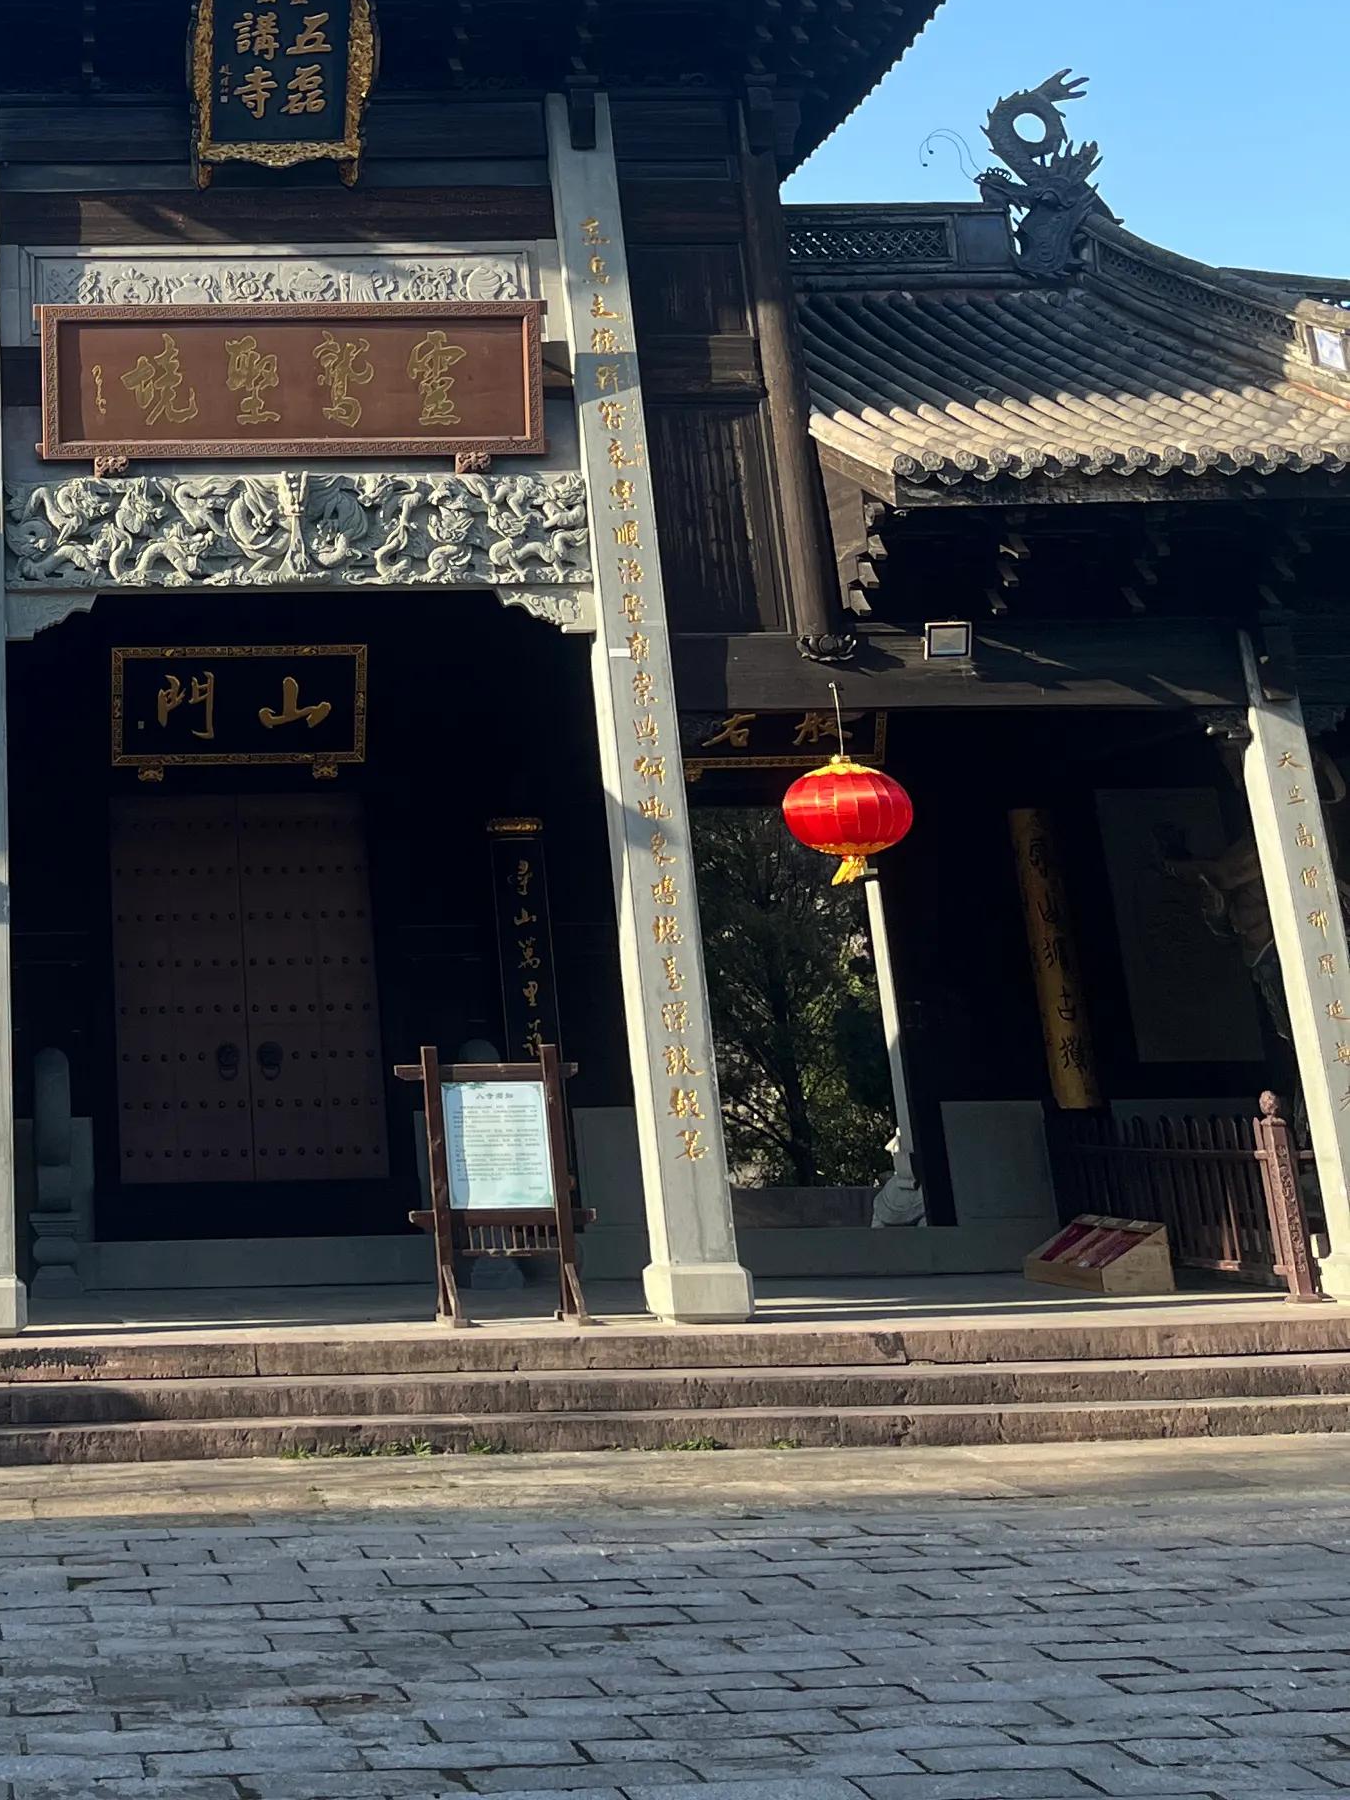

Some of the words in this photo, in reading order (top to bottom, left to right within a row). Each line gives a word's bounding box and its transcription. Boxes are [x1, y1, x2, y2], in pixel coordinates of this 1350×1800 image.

[233, 11, 281, 120] 講寺
[280, 12, 333, 115] 五磊
[156, 670, 332, 740] 山門
[700, 712, 866, 748] 般若
